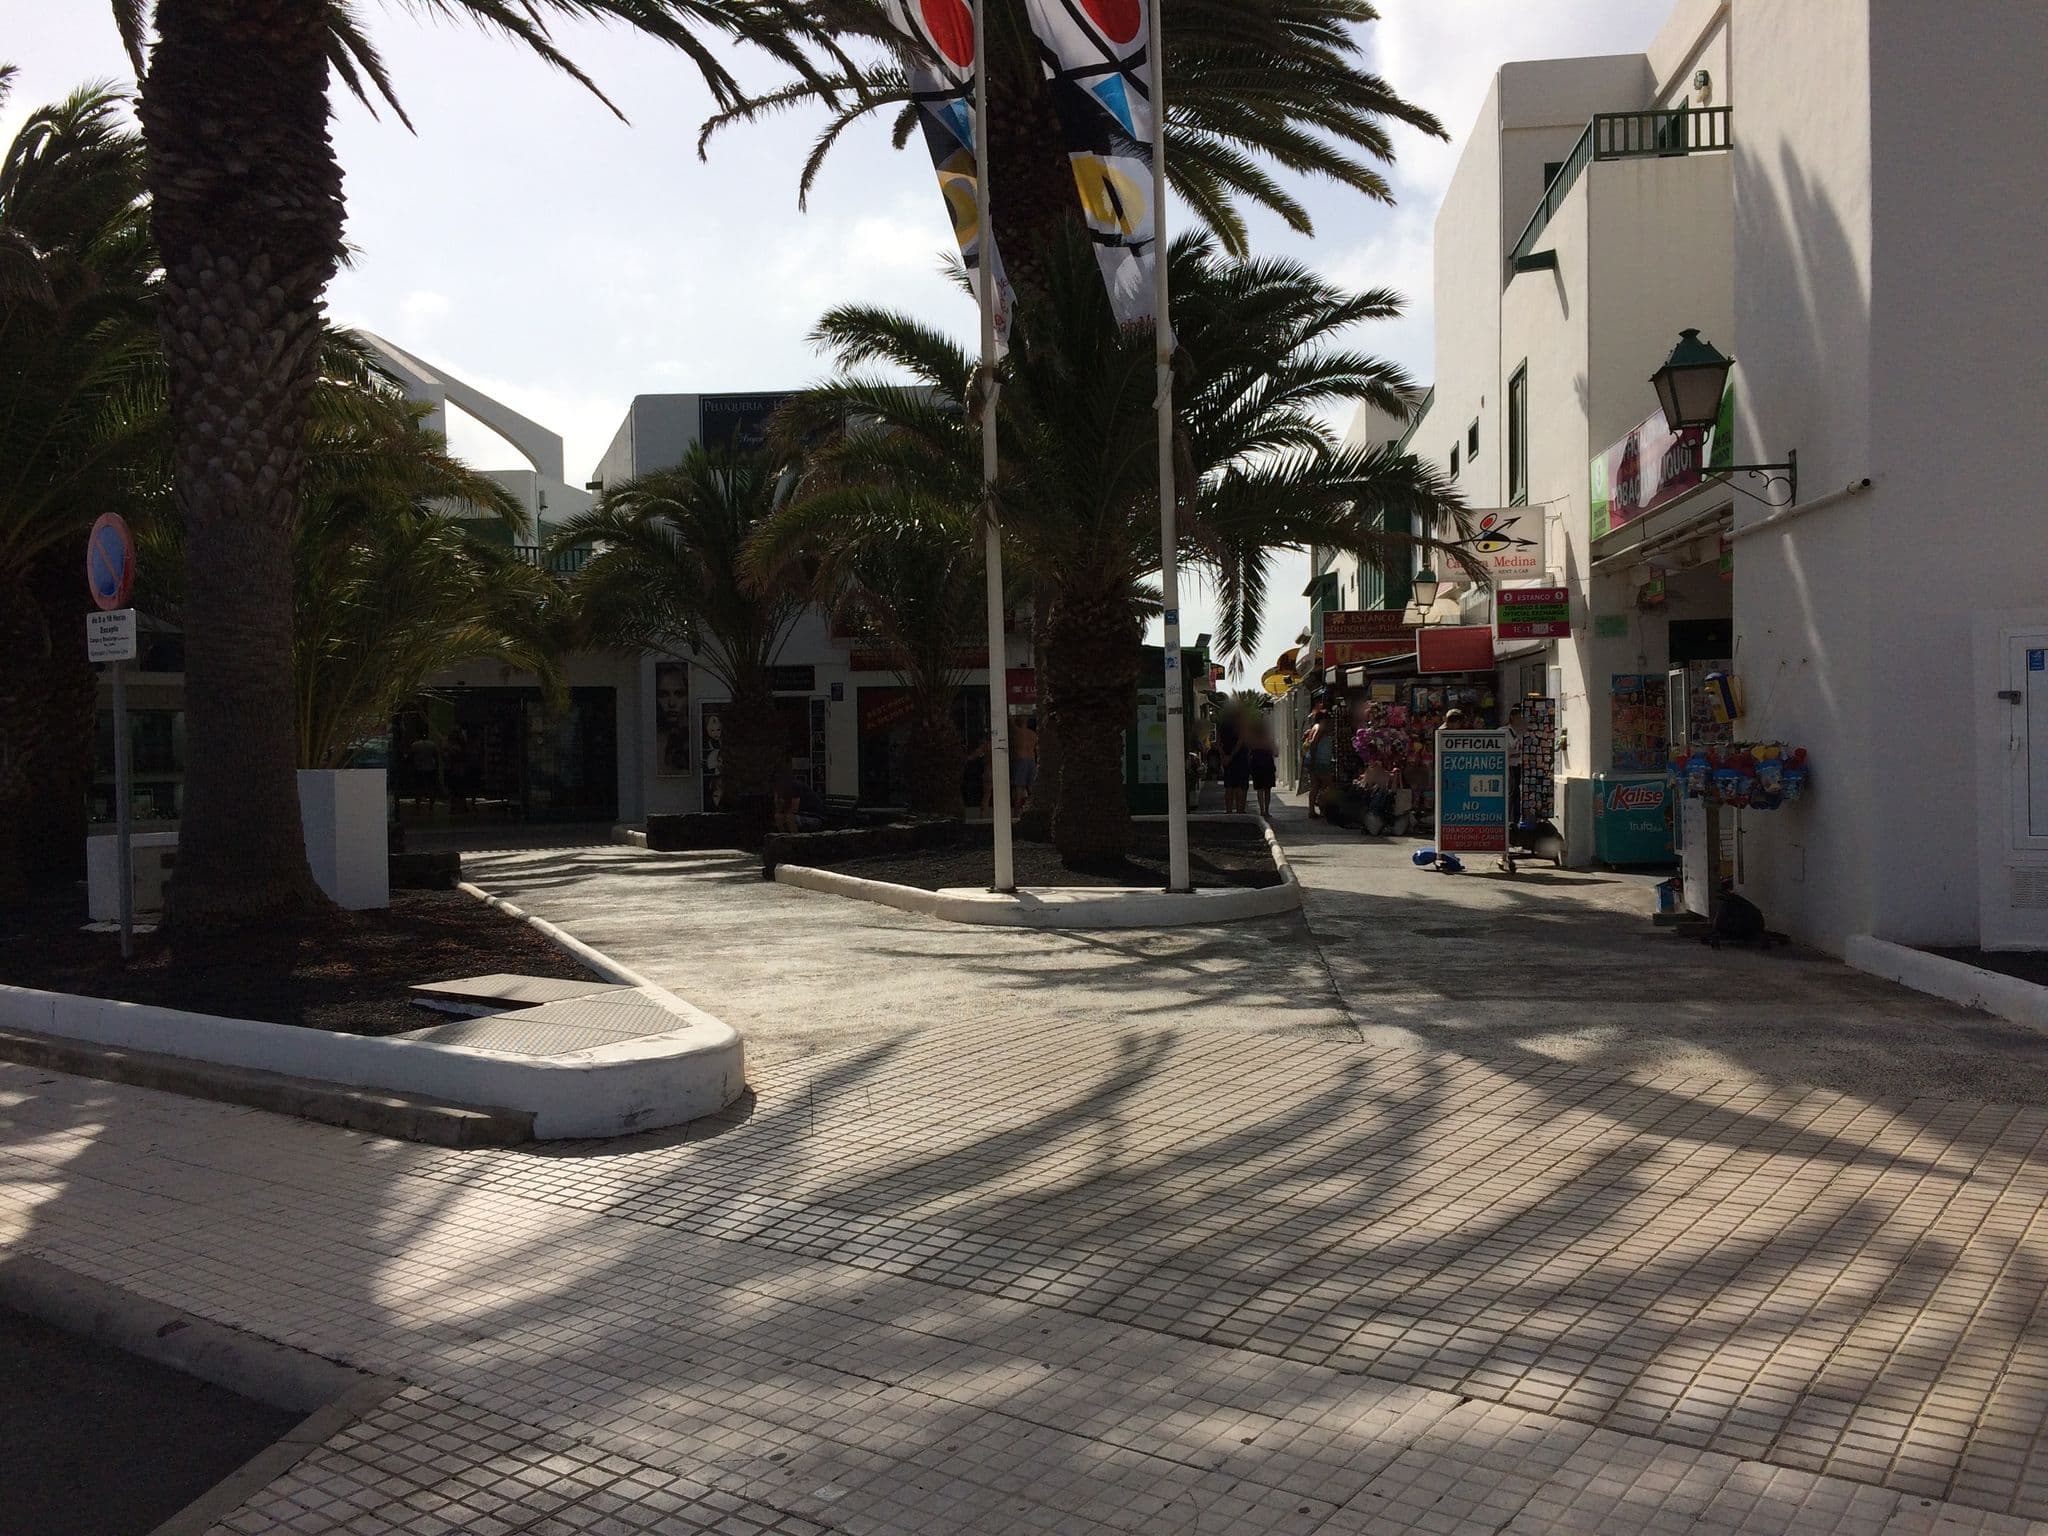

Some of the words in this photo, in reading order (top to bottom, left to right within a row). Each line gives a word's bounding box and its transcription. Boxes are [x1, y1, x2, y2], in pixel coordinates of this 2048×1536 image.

[1494, 556, 1536, 568] Medina
[1351, 615, 1395, 623] ESTANCO
[1445, 738, 1501, 749] OFFICIAL
[1443, 755, 1504, 771] EXCHANGE
[1612, 784, 1664, 810] Kalise
[1463, 801, 1480, 811] NO
[1443, 812, 1503, 822] COMMISSION
